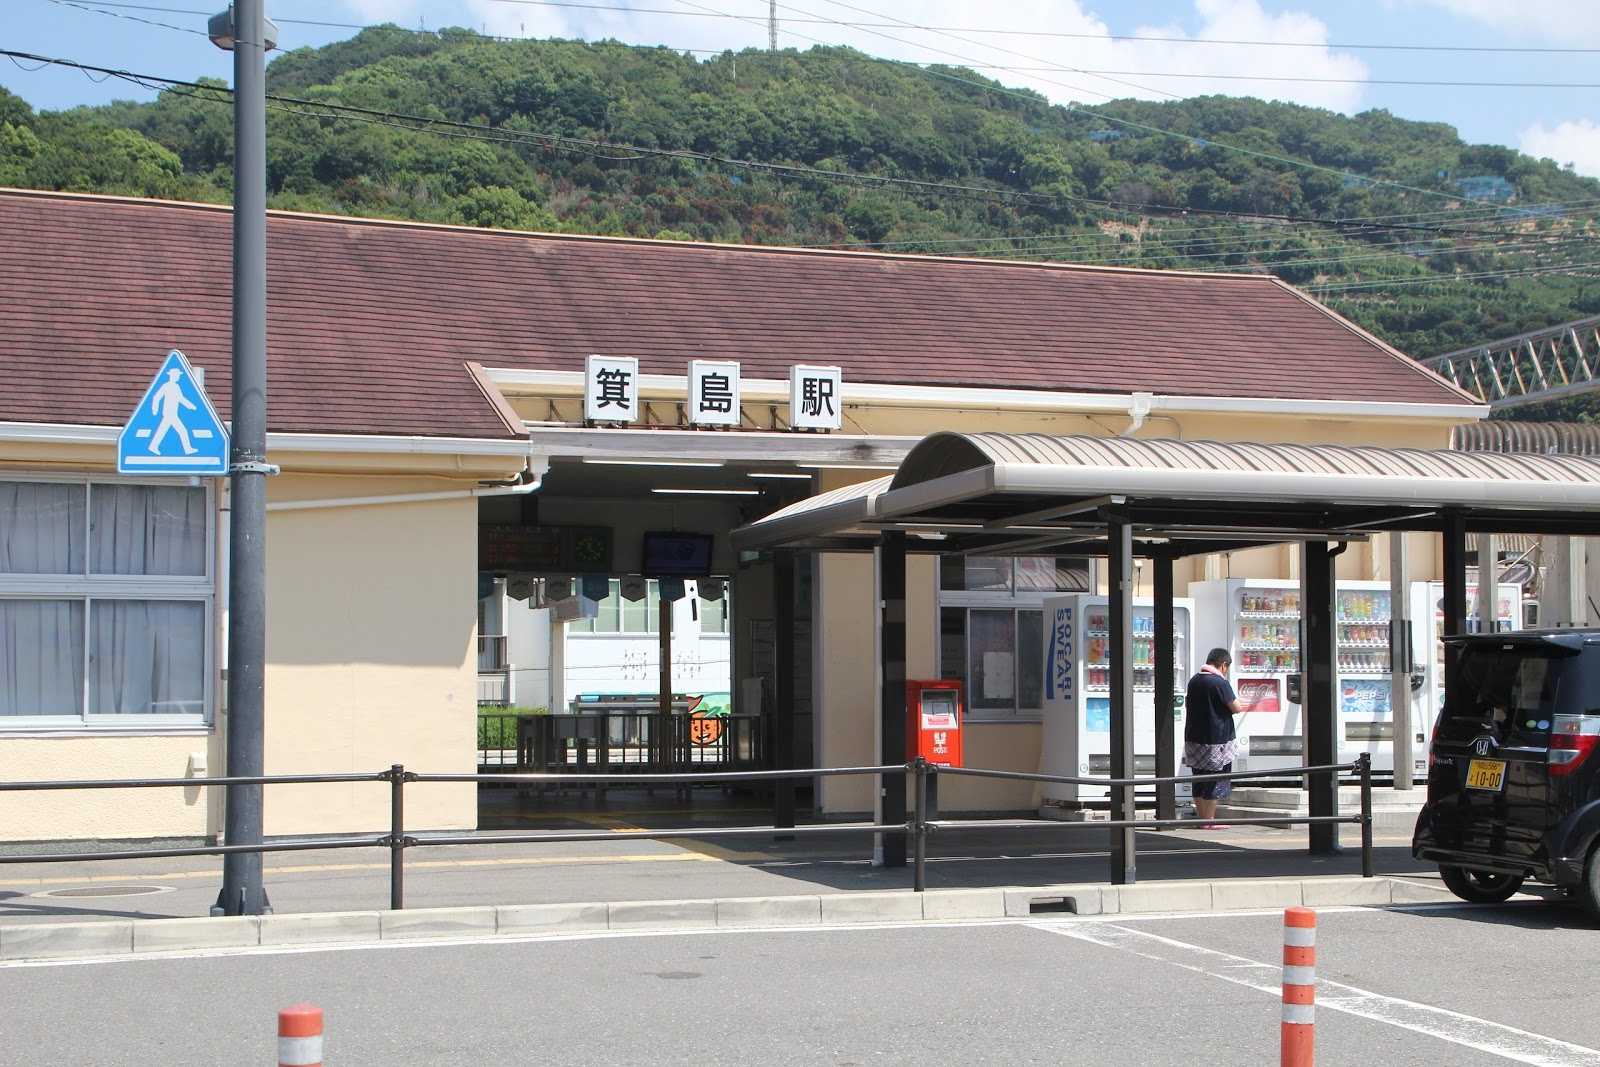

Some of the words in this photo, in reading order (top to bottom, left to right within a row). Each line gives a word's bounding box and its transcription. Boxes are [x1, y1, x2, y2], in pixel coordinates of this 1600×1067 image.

[595, 367, 835, 417] 箕島駅
[1056, 608, 1064, 690] SWEAT
[1063, 607, 1072, 701] POCARI
[1357, 687, 1386, 701] PEPSI
